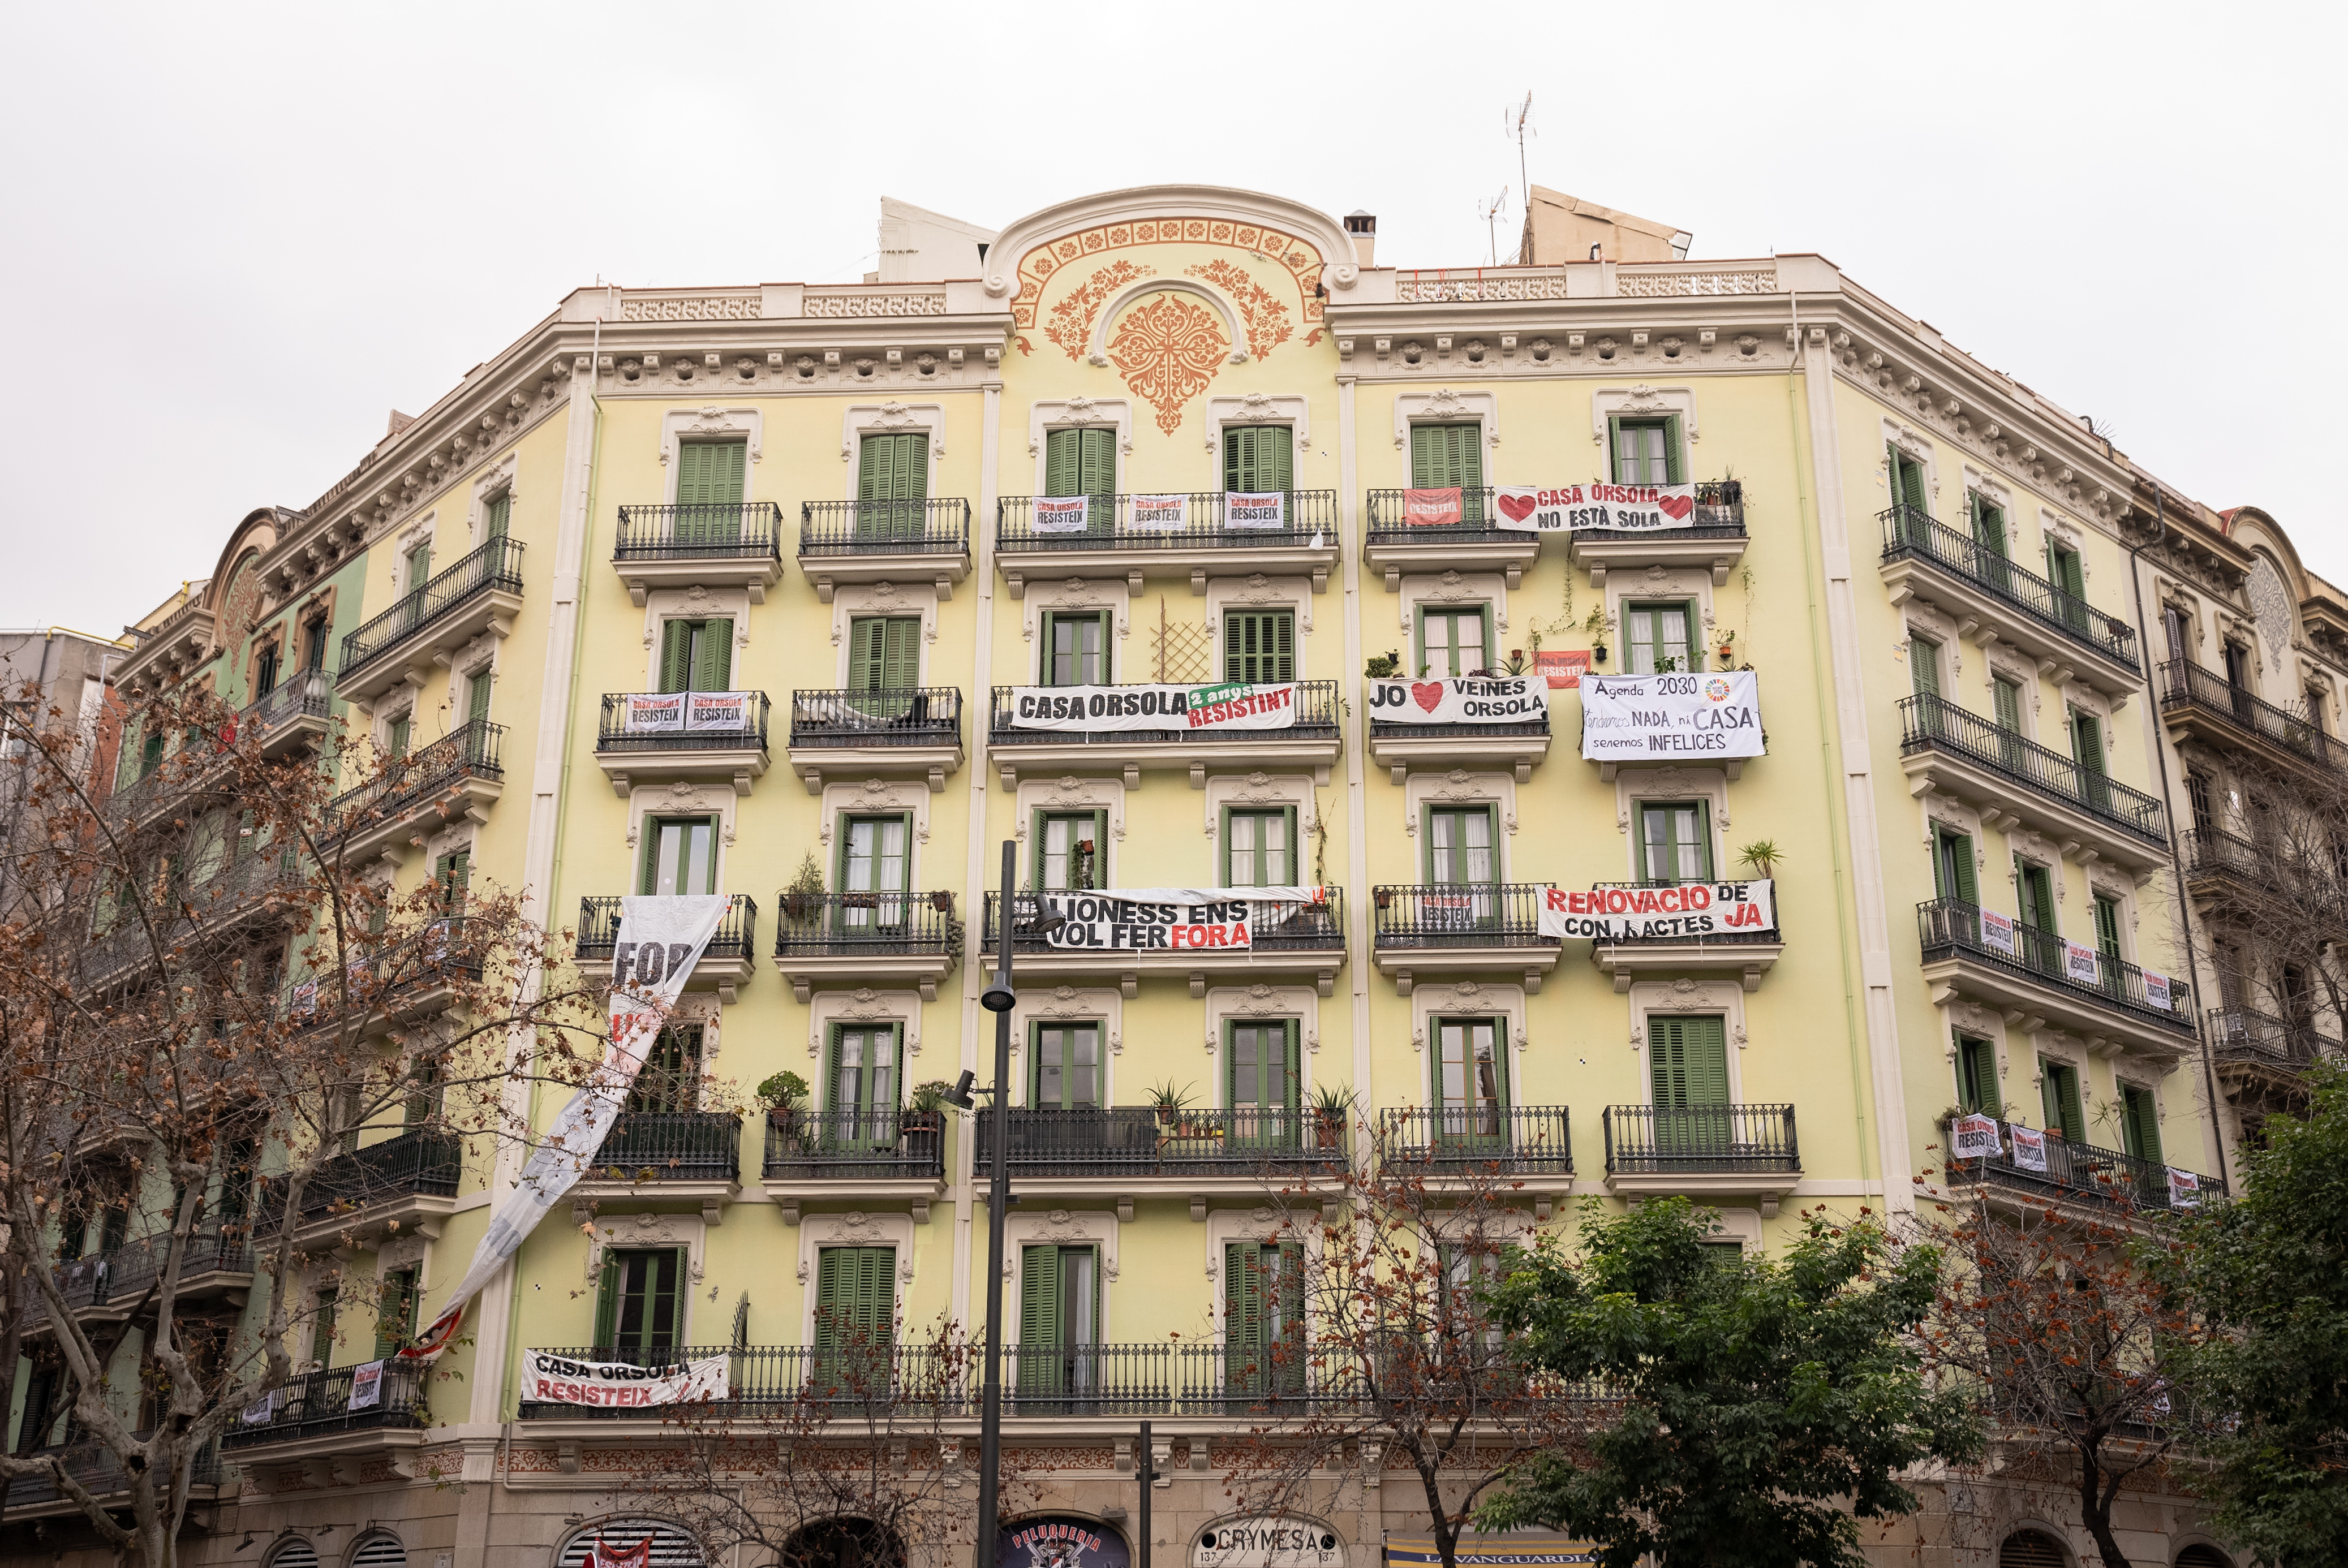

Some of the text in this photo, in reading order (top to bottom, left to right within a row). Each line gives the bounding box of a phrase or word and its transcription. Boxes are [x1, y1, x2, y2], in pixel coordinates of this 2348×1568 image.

[1136, 499, 1181, 509] CASA ORSOLA
[1231, 498, 1278, 507] CASA ORSOLA
[1537, 485, 1659, 507] CASA ORSOLA
[1038, 502, 1083, 511] CASA ORSOLA
[1231, 507, 1278, 520] RESISTEIX
[1409, 502, 1457, 514] RESISTEIX
[1038, 510, 1082, 524] RESISTEIX
[1135, 509, 1181, 522] RESISTEIX
[1537, 506, 1661, 528] NO ESTÀ SOLA
[1537, 665, 1586, 677] RESISTEIX
[1190, 686, 1252, 707] 2 anys
[1369, 679, 1526, 708] JO VEÏNES
[1594, 677, 1697, 699] Agenda 2030
[633, 699, 679, 709] CASA ORSOLA
[715, 699, 742, 707] ORSOLA
[1020, 691, 1188, 720] CASA ORSOLA
[1187, 687, 1292, 728] RESISTINT
[1464, 695, 1545, 717] ORSOLA
[633, 708, 678, 723] RESISTEIX
[694, 708, 741, 721] RESISTEIX
[1679, 715, 1690, 726] ni
[1693, 706, 1754, 731] CASA
[1593, 733, 1726, 751] seremos INFELICES
[1718, 885, 1748, 902] DE
[1188, 900, 1248, 924] ENS
[1422, 906, 1471, 922] RESISTEIX
[1565, 903, 1764, 940] CONACTES JA
[1051, 922, 1250, 948] VOL FER FORA
[1985, 920, 2012, 945] RESISTEIX
[1958, 1122, 1976, 1133] CASA
[536, 1356, 591, 1379] CASA
[536, 1380, 653, 1406] RESISTEIX
[1012, 1524, 1101, 1552] PELUQUERIA
[1218, 1529, 1318, 1550] CRYMESA
[1200, 1552, 1217, 1562] 137
[1318, 1552, 1335, 1562] 137
[1453, 1554, 1596, 1564] VANGUARDIA
